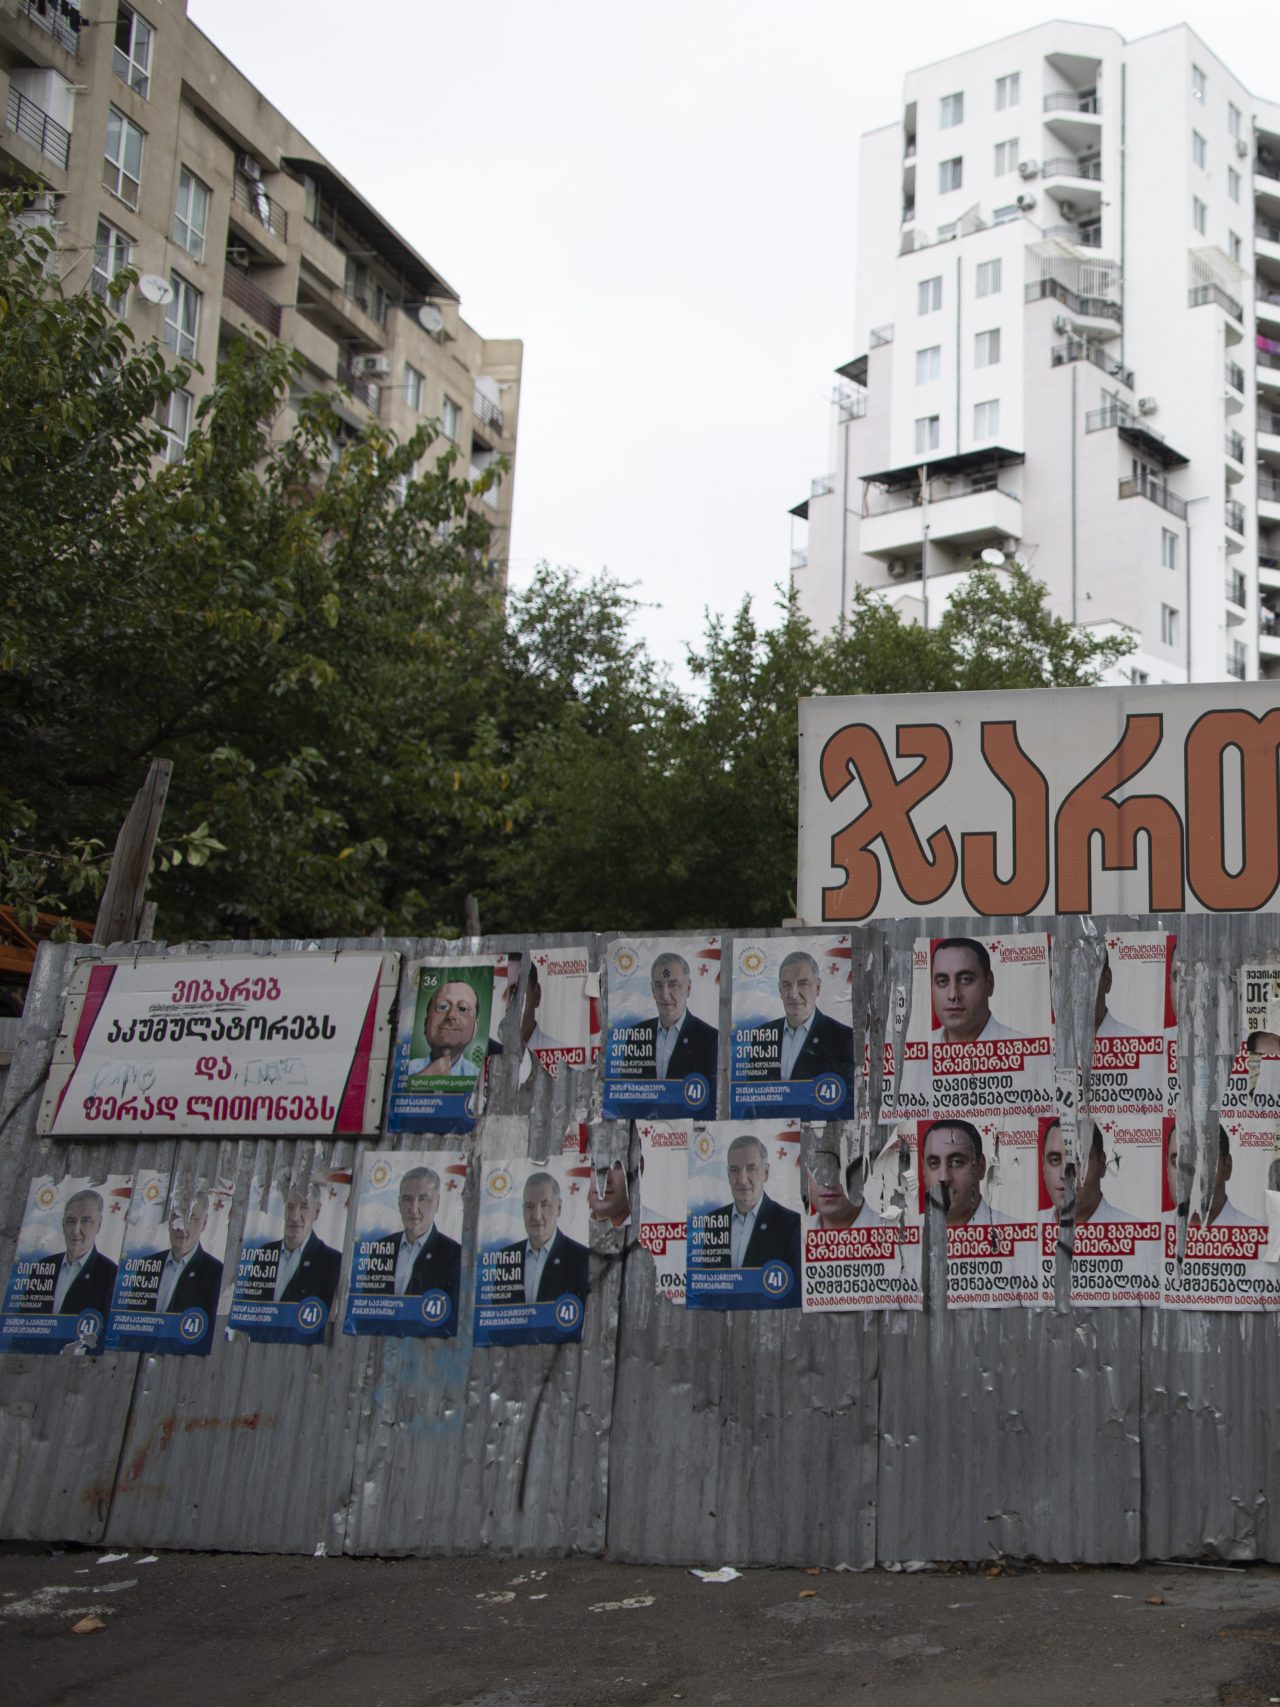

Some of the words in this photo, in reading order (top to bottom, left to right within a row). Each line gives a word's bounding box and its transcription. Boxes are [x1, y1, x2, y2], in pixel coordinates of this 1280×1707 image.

[423, 976, 437, 986] 36
[171, 977, 281, 1003] ვიბარებ
[107, 1015, 336, 1042] აკუმულატორებს
[612, 1028, 652, 1042] გიორგი
[736, 1028, 778, 1042] გიორგი
[611, 1044, 653, 1057] ვოლსკი
[736, 1044, 778, 1059] ვოლსკი
[934, 1044, 993, 1060] გიორგი
[997, 1041, 1049, 1056] ვაშაძე
[1113, 1038, 1163, 1053] ვაშაძე
[195, 1056, 232, 1080] და
[933, 1057, 1021, 1074] პრემიერად
[688, 1084, 701, 1099] 41
[820, 1084, 836, 1099] 41
[932, 1076, 1013, 1092] დავიწყოთ
[933, 1090, 1054, 1107] აღმშენებლობა,
[84, 1096, 178, 1120] ფერად
[187, 1096, 335, 1120] ლითონებს
[692, 1214, 730, 1229] გიორგი
[692, 1231, 730, 1246] ვოლსკი
[808, 1230, 867, 1246] გიორგი
[1045, 1225, 1105, 1239] გირგი
[1108, 1224, 1160, 1239] ვაშაძე
[1168, 1227, 1229, 1242] გორგი
[1232, 1228, 1268, 1242] ვაშა
[240, 1248, 279, 1262] გიორგი
[359, 1241, 395, 1256] გიორგი
[808, 1243, 893, 1260] პრემიერად
[1168, 1242, 1256, 1258] პემიერად
[125, 1259, 161, 1273] გიორგი
[358, 1257, 394, 1272] ვოლსკი
[482, 1251, 521, 1266] გიორგი
[1042, 1259, 1124, 1273] დიწყოთ
[17, 1261, 56, 1276] გიორგი
[238, 1264, 277, 1278] ვოლსკი
[482, 1267, 521, 1283] ვოლსკი
[806, 1263, 885, 1279] დავიწყოთ
[1165, 1262, 1246, 1277] დვიწყოთ
[14, 1279, 53, 1292] ვოლსკი
[122, 1275, 159, 1289] ვოლსკი
[768, 1273, 783, 1287] 41
[303, 1309, 318, 1323] 41
[426, 1301, 441, 1316] 41
[560, 1304, 575, 1320] 41
[80, 1319, 95, 1334] 41
[184, 1318, 199, 1333] 41
